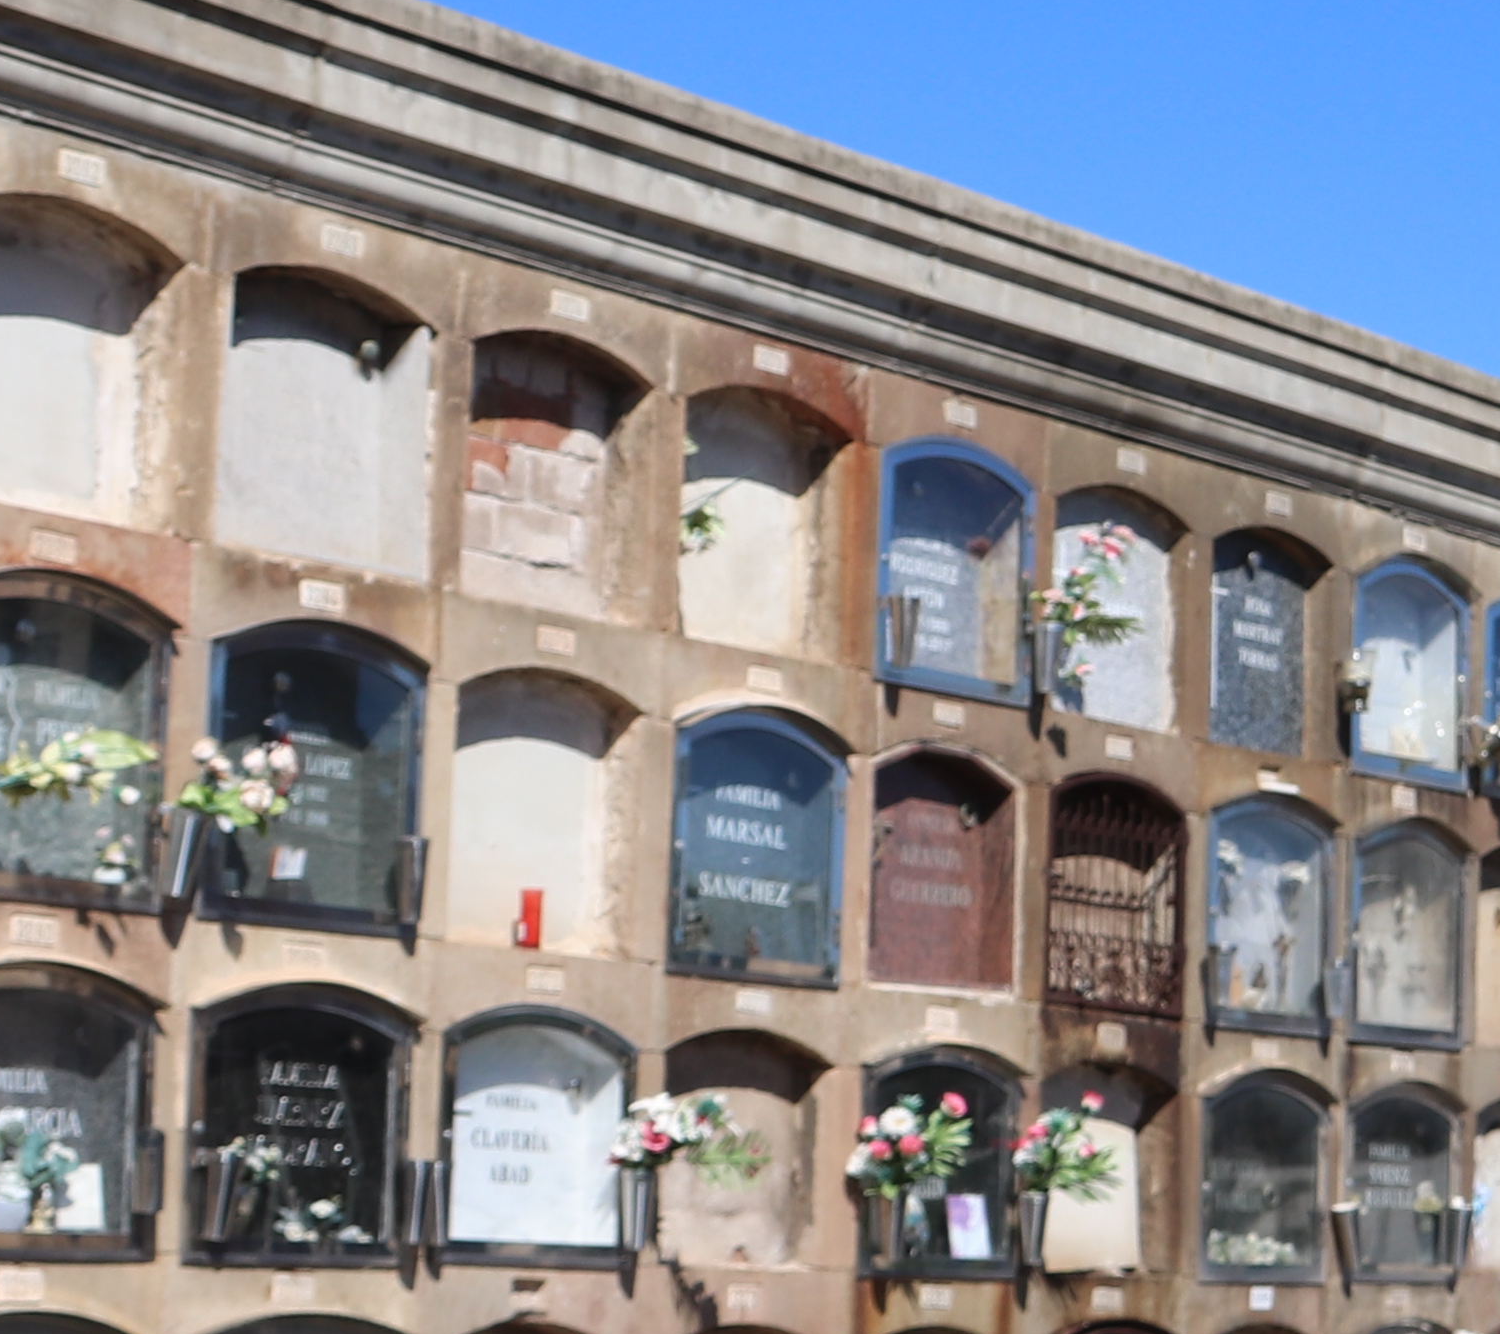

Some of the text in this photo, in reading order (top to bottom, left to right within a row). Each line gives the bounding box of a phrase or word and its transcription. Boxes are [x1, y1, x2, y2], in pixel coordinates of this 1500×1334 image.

[715, 783, 781, 810] FAMILIA
[706, 814, 787, 850] MARSAL
[699, 870, 790, 908] SANCHEZ
